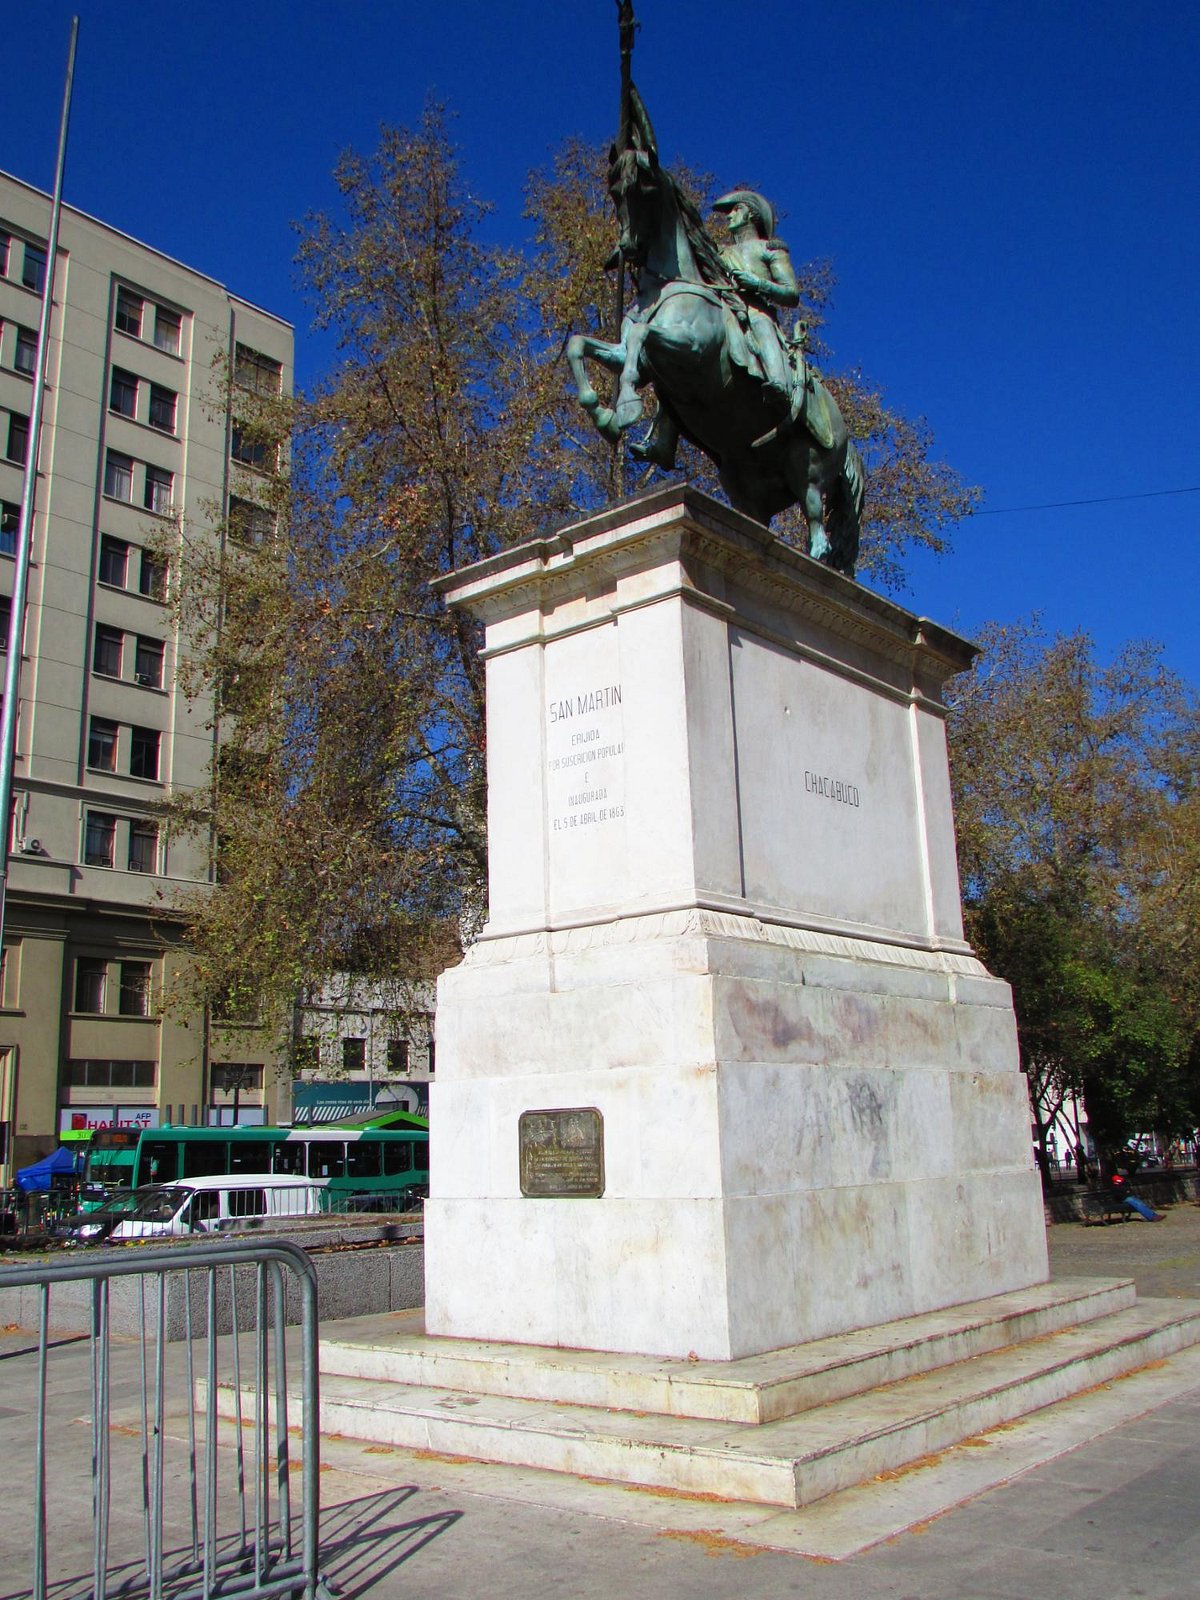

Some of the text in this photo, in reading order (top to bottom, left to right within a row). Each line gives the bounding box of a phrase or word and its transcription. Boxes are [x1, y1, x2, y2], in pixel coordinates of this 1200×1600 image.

[550, 684, 622, 723] SAN MARTIN
[804, 770, 860, 807] CHACABUCO
[135, 1112, 151, 1120] AFP
